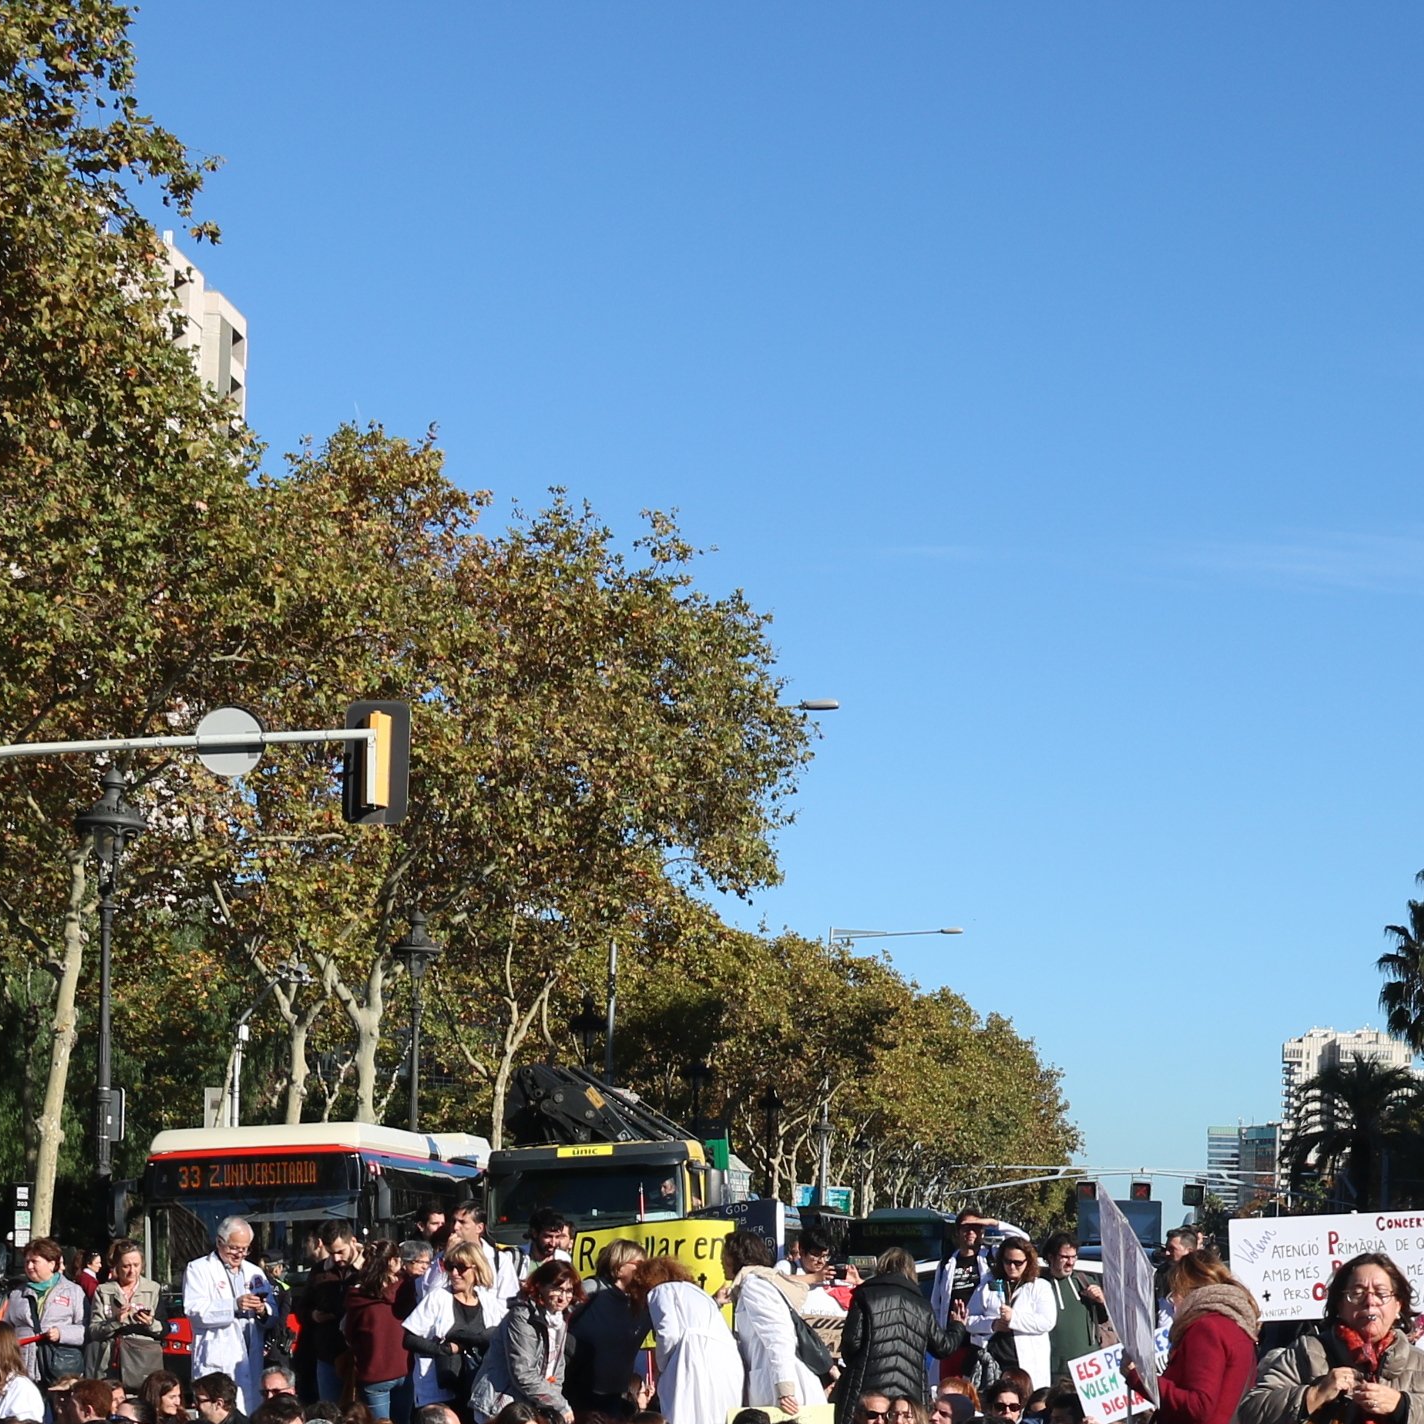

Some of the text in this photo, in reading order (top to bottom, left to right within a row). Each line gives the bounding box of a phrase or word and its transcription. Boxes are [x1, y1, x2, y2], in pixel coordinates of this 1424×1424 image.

[178, 1160, 318, 1188] 33 Z.UNIVERSITARIA
[1271, 1237, 1320, 1260] ATENCIÓ
[1327, 1231, 1387, 1255] PRIMÀRIA
[1395, 1237, 1409, 1251] DE
[1262, 1268, 1291, 1282] AMB
[1294, 1262, 1320, 1281] MÉS
[1076, 1357, 1102, 1381] ELS
[1080, 1373, 1119, 1400] VOLEM
